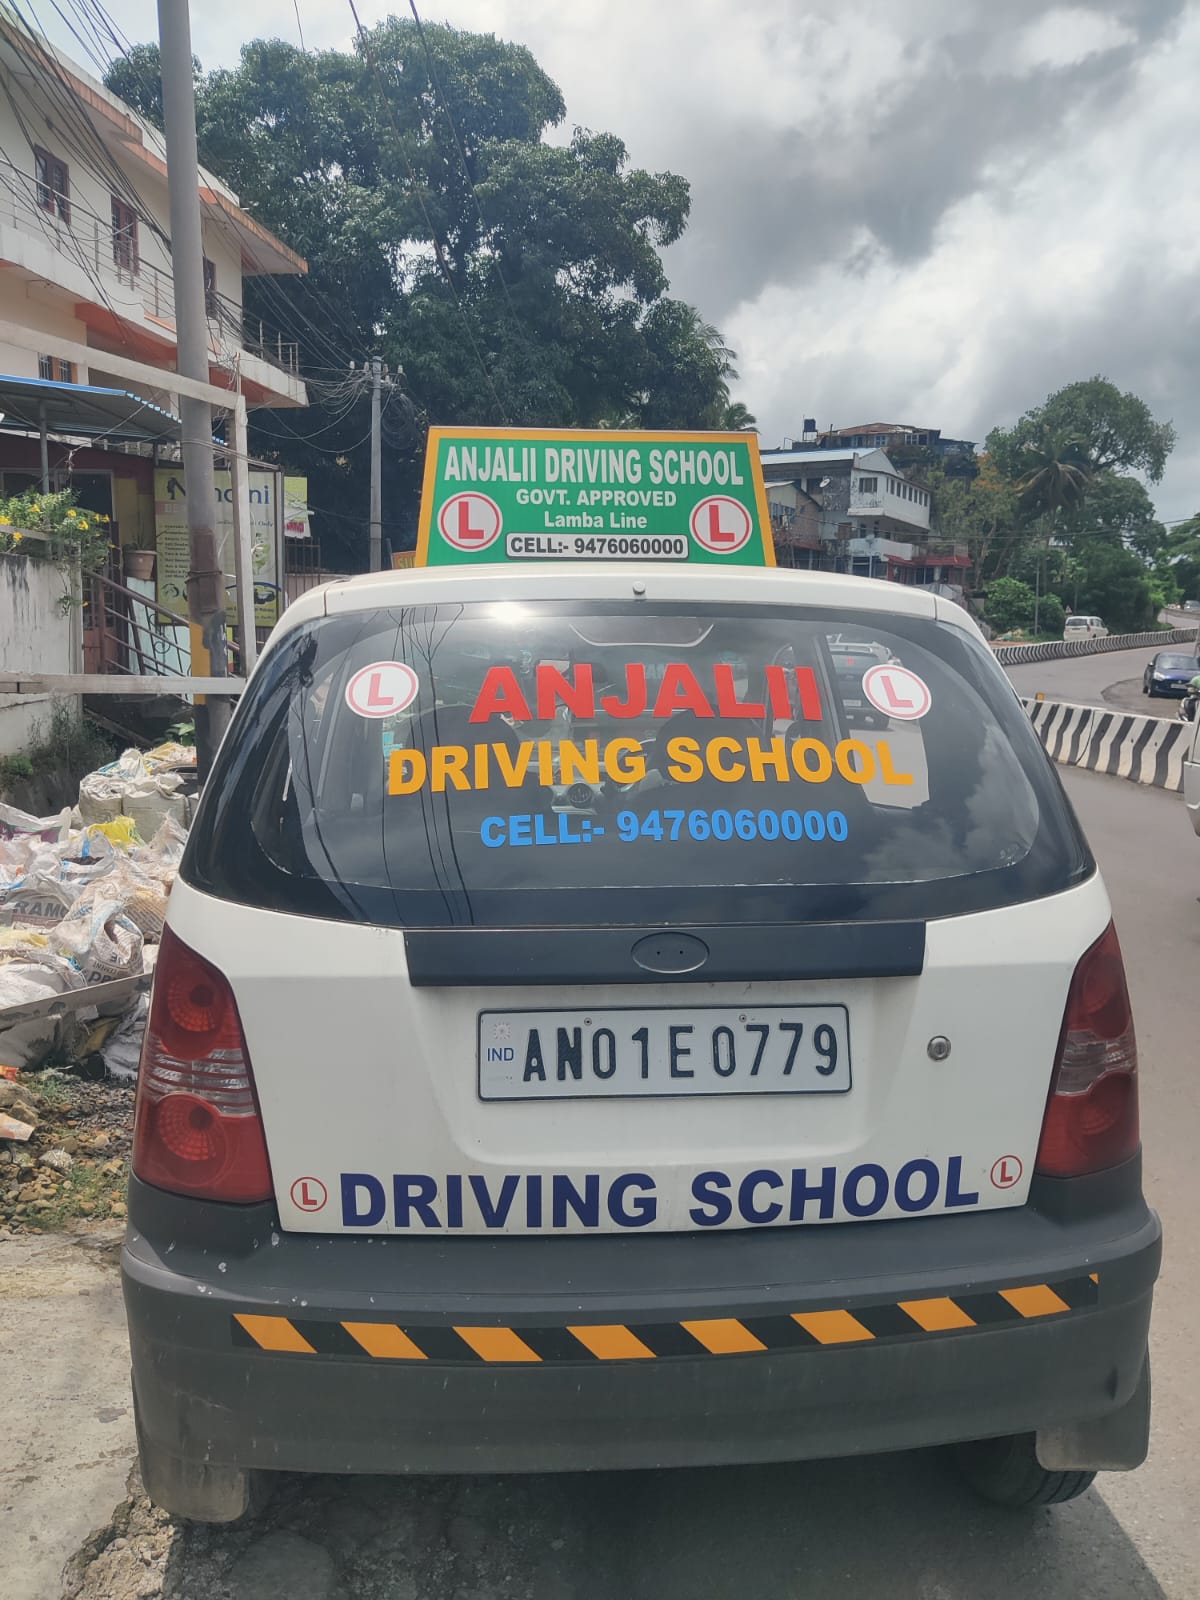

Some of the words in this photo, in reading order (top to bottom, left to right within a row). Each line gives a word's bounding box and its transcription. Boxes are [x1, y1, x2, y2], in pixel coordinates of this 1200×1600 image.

[445, 446, 537, 482] ANJALII
[545, 448, 642, 484] DRIVING
[649, 450, 744, 486] SCHOOL
[516, 488, 571, 505] GOVT.
[577, 489, 677, 507] APPROVED
[458, 501, 484, 539] L
[544, 511, 604, 528] Lamba
[609, 512, 648, 529] Line
[708, 504, 736, 542] L
[510, 537, 569, 554] CELL:-
[574, 537, 684, 555] 9476060000
[367, 673, 394, 707] L
[469, 663, 823, 723] ANJALII
[880, 675, 914, 708] L
[388, 737, 647, 795] DRIVING
[666, 736, 914, 785] SCHOOL
[480, 813, 605, 848] CELL:-
[617, 810, 848, 842] 9476060000
[487, 1047, 514, 1061] IND
[523, 1022, 838, 1081] AN01E0779
[340, 1173, 657, 1228] DRIVING
[689, 1155, 980, 1227] SCHOOL
